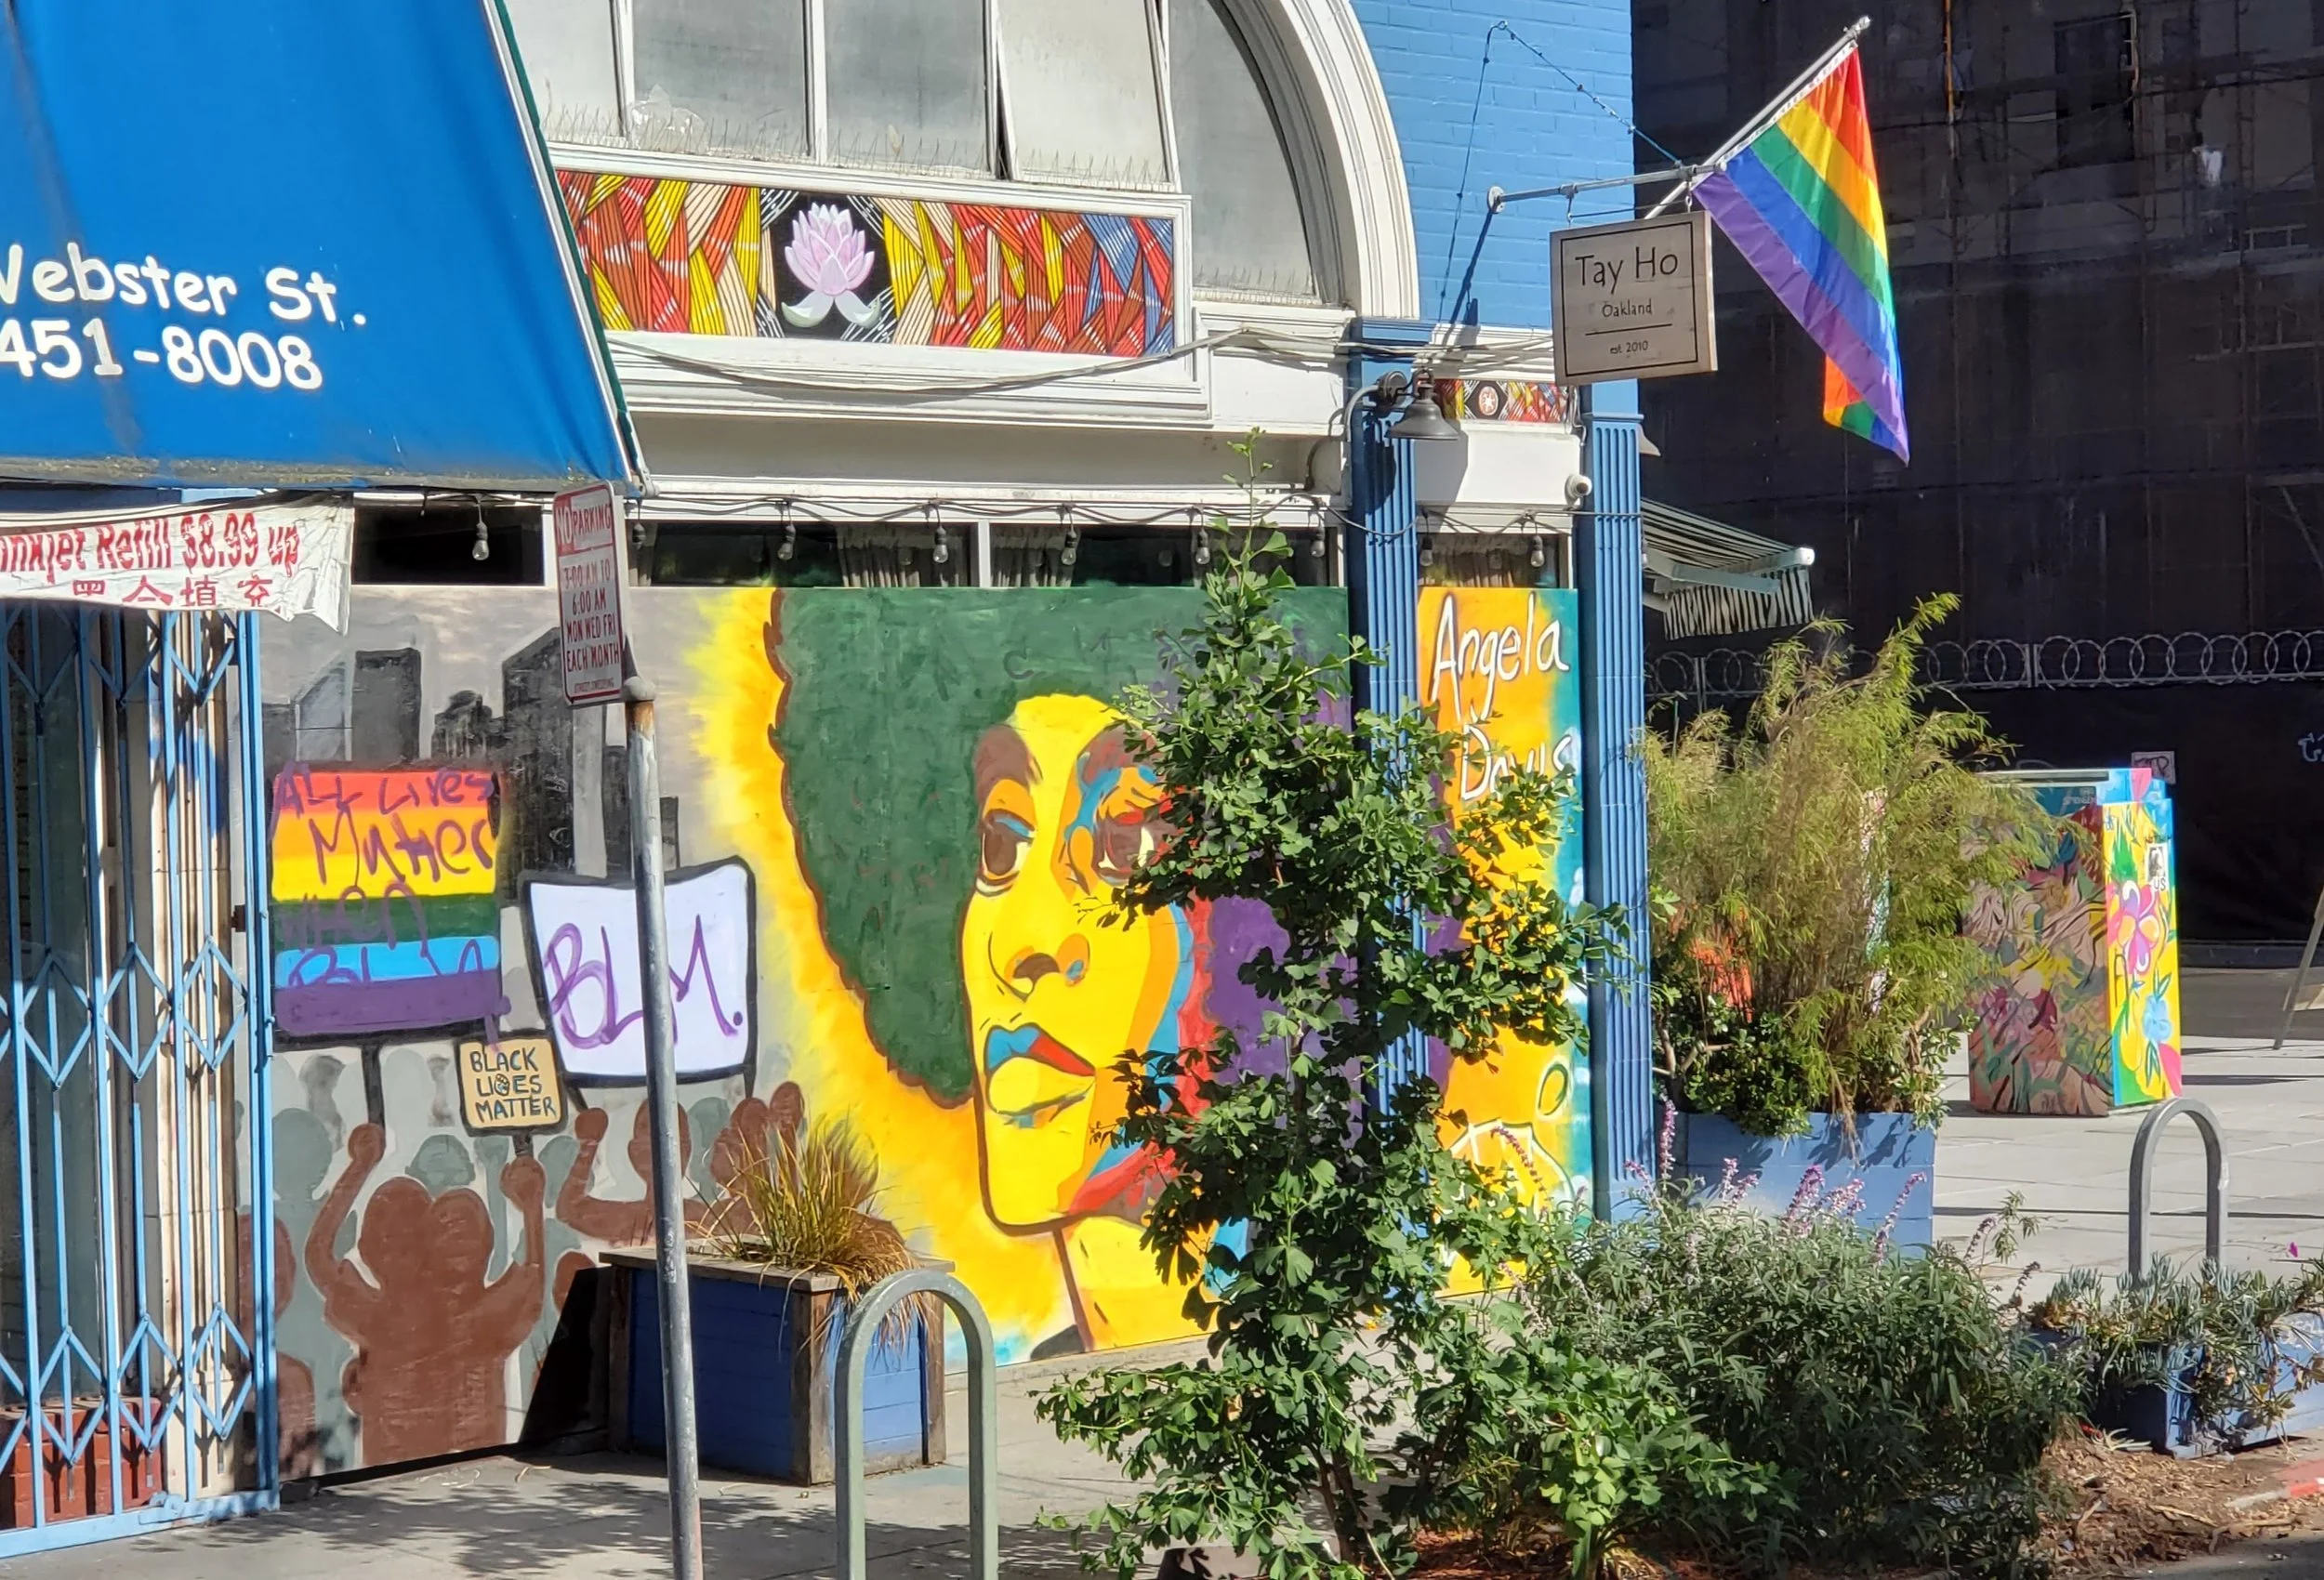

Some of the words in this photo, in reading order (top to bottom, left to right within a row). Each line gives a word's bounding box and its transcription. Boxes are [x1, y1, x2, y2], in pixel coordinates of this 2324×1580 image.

[1575, 254, 1624, 295] Tay
[1635, 246, 1679, 279] Ho
[265, 267, 366, 324] St.
[1602, 297, 1653, 318] Oakland
[1609, 345, 1622, 355] est
[1626, 340, 1649, 353] 2010
[555, 506, 573, 545] NO
[572, 503, 612, 536] PARKING
[96, 517, 173, 570] Refill
[180, 512, 259, 573] $8.99
[269, 524, 300, 577] up
[587, 561, 599, 586] AM
[601, 559, 611, 584] TO
[572, 590, 591, 615] 6:00
[595, 586, 607, 611] AM
[566, 619, 583, 643] MON
[585, 614, 601, 639] WED
[603, 612, 616, 637] FRI
[567, 647, 588, 672] EACH
[590, 642, 620, 668] MONTH
[1430, 591, 1570, 724] Angela
[469, 1047, 539, 1073] BLACK
[475, 1073, 543, 1098] LIES
[474, 1096, 558, 1123] MATTER
